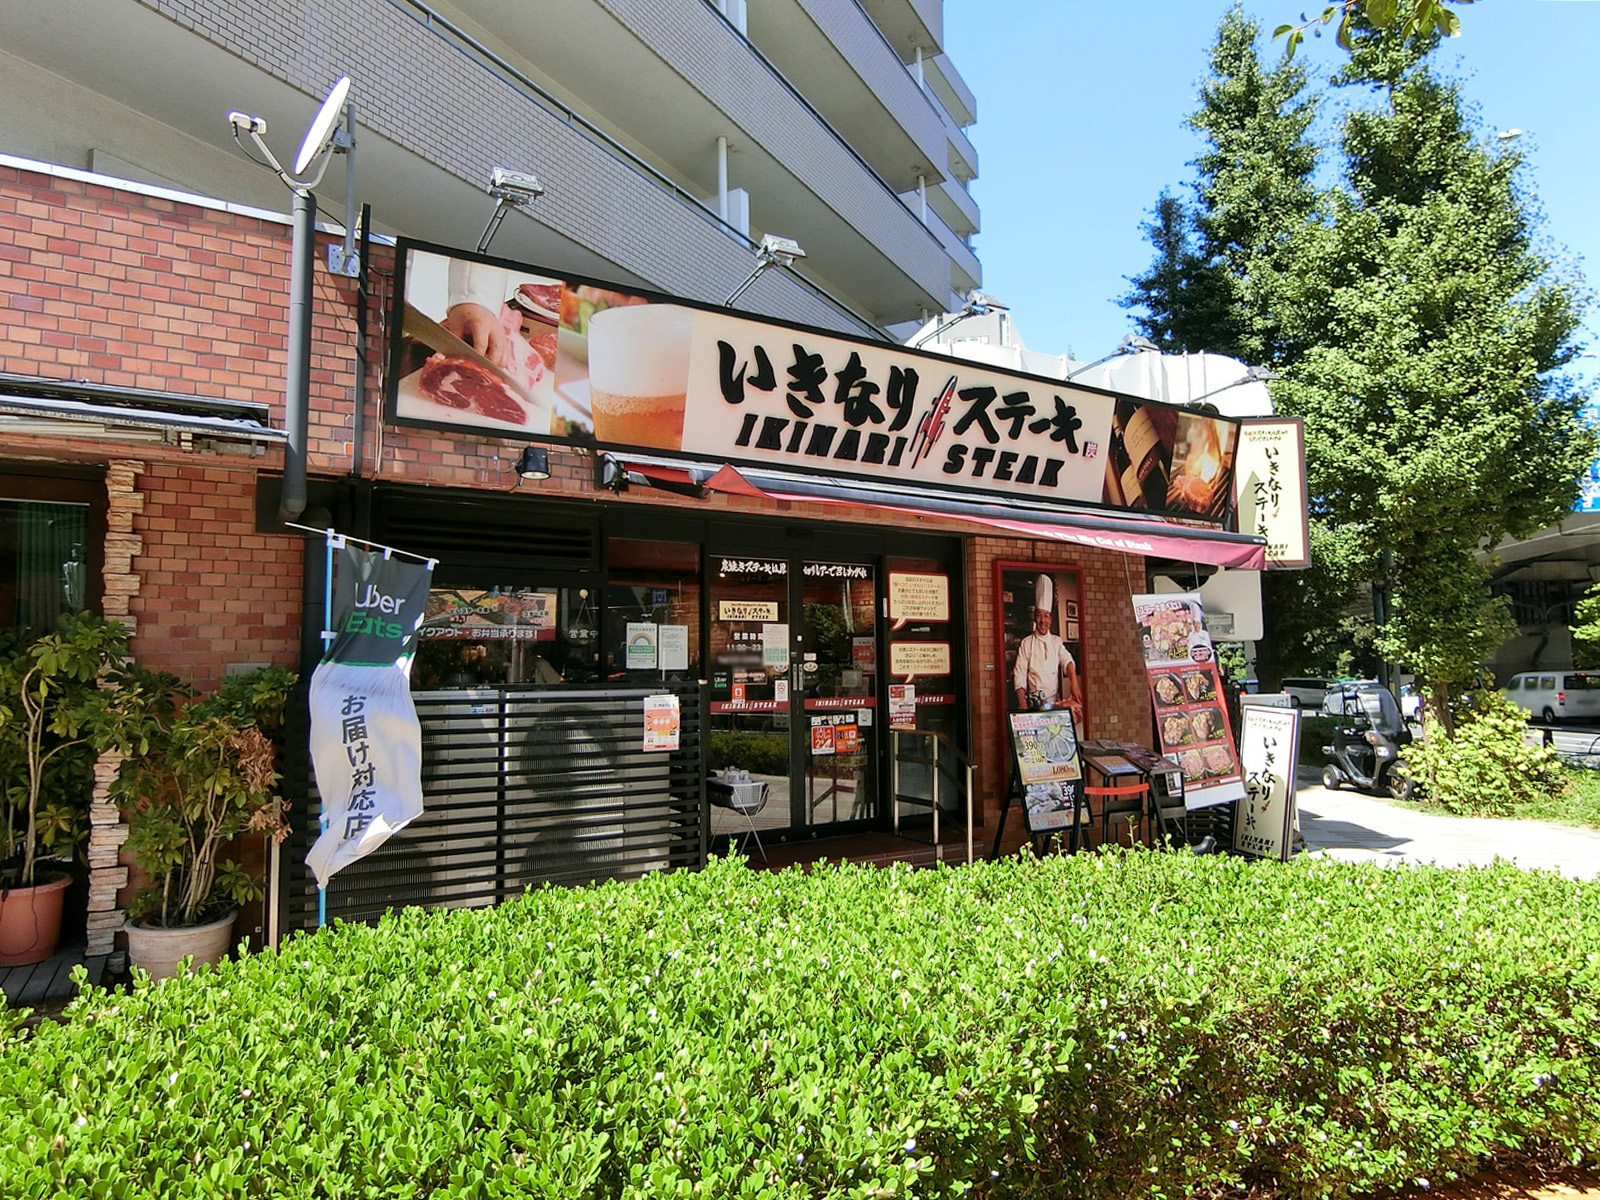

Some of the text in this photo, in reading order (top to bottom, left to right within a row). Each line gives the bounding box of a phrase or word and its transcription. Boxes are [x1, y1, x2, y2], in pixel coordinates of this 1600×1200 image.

[717, 339, 1082, 454] いきなり ステーキ
[735, 412, 1065, 488] IKINARI STEAK
[1264, 446, 1282, 508] いきなり
[1253, 482, 1269, 538] ステーキ
[353, 582, 406, 617] Uber
[344, 610, 404, 640] Eats
[418, 627, 539, 640] イクアウト・お弁当承ります!
[569, 629, 599, 639] 営業中
[753, 701, 778, 709] STEAK
[815, 699, 840, 707] IKINARI
[339, 694, 378, 842] お届け対応店
[1261, 736, 1278, 801] いきなり
[1245, 771, 1260, 830] ステーキ
[1240, 833, 1275, 847] IKINARI
